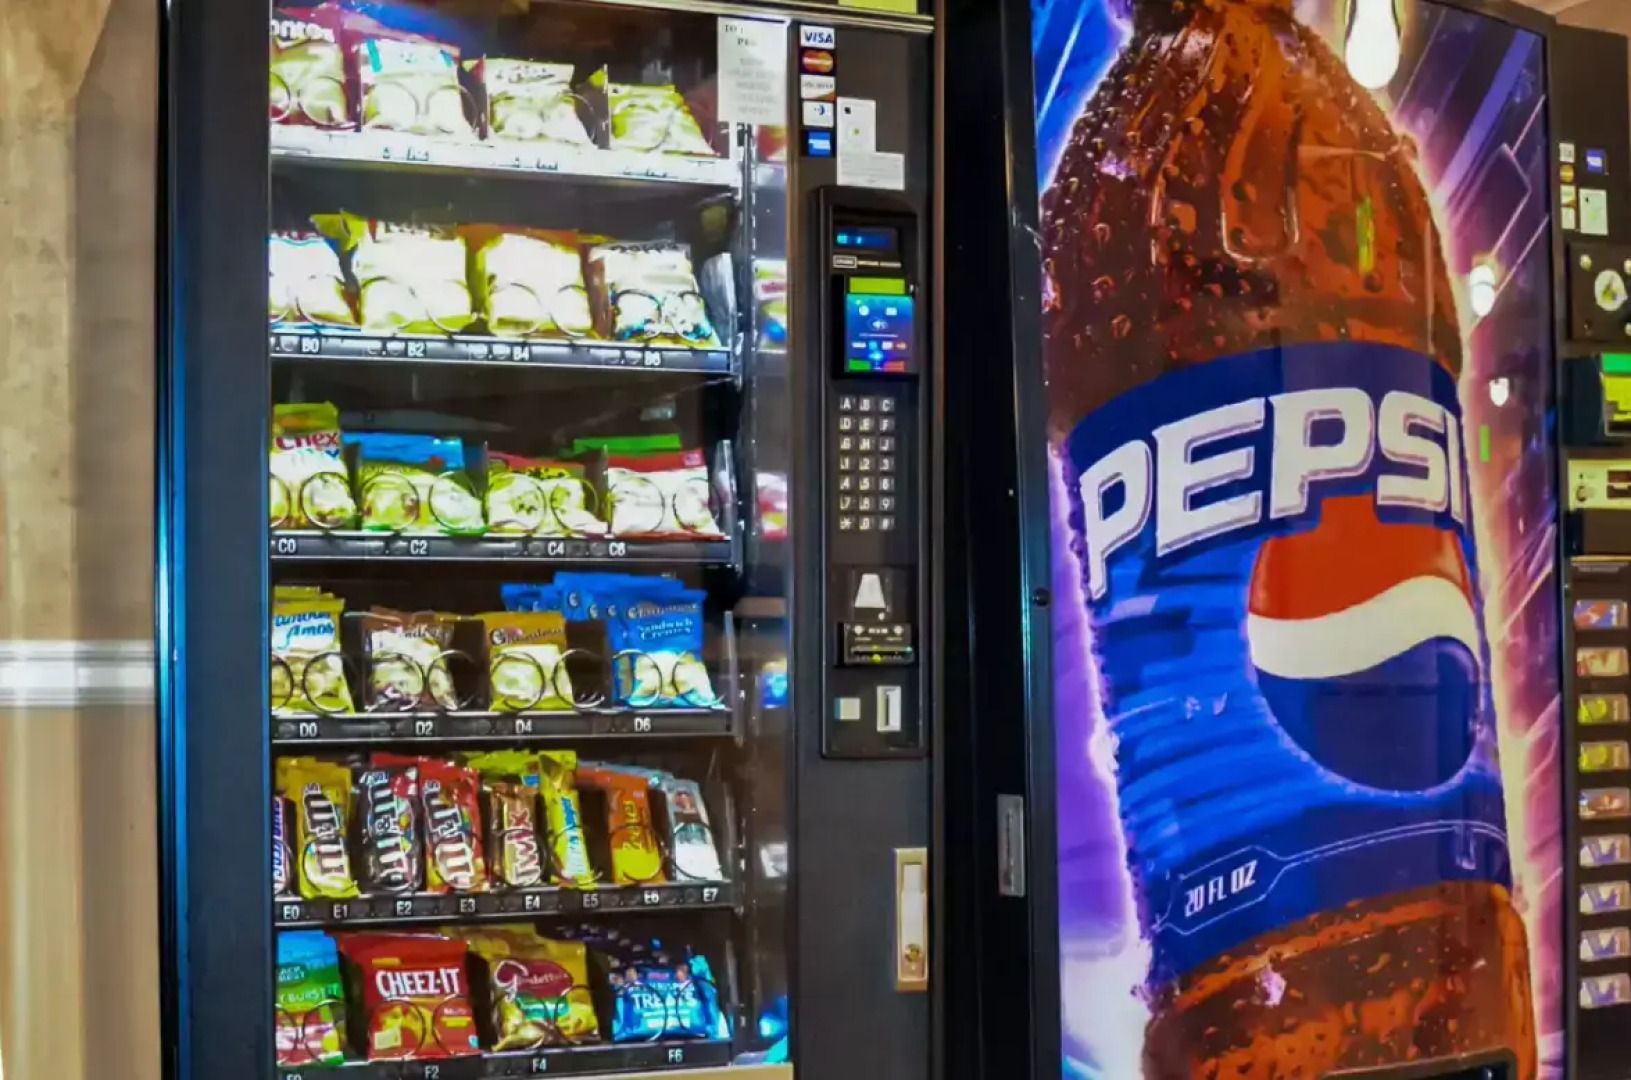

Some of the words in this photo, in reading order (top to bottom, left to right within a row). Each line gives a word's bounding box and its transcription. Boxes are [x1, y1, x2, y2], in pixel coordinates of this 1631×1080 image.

[804, 32, 834, 43] VISA
[1079, 387, 1464, 601] PEPSI
[278, 538, 297, 553] C0
[410, 540, 428, 555] C2
[548, 541, 564, 555] C4
[300, 722, 317, 737] D0
[415, 721, 433, 736] D2
[515, 719, 533, 734] D4
[634, 717, 651, 732] D6
[703, 888, 719, 902] E7
[1184, 884, 1205, 918] 20
[1208, 875, 1228, 905] FL
[1231, 859, 1258, 894] OZ
[396, 901, 412, 916] E2
[583, 894, 598, 908] E5
[283, 905, 299, 919] E0
[333, 905, 348, 918] E1
[375, 968, 460, 998] CHEEZ-IT
[668, 1048, 684, 1062] F6
[425, 1065, 439, 1079] F2
[532, 1058, 547, 1072] F4
